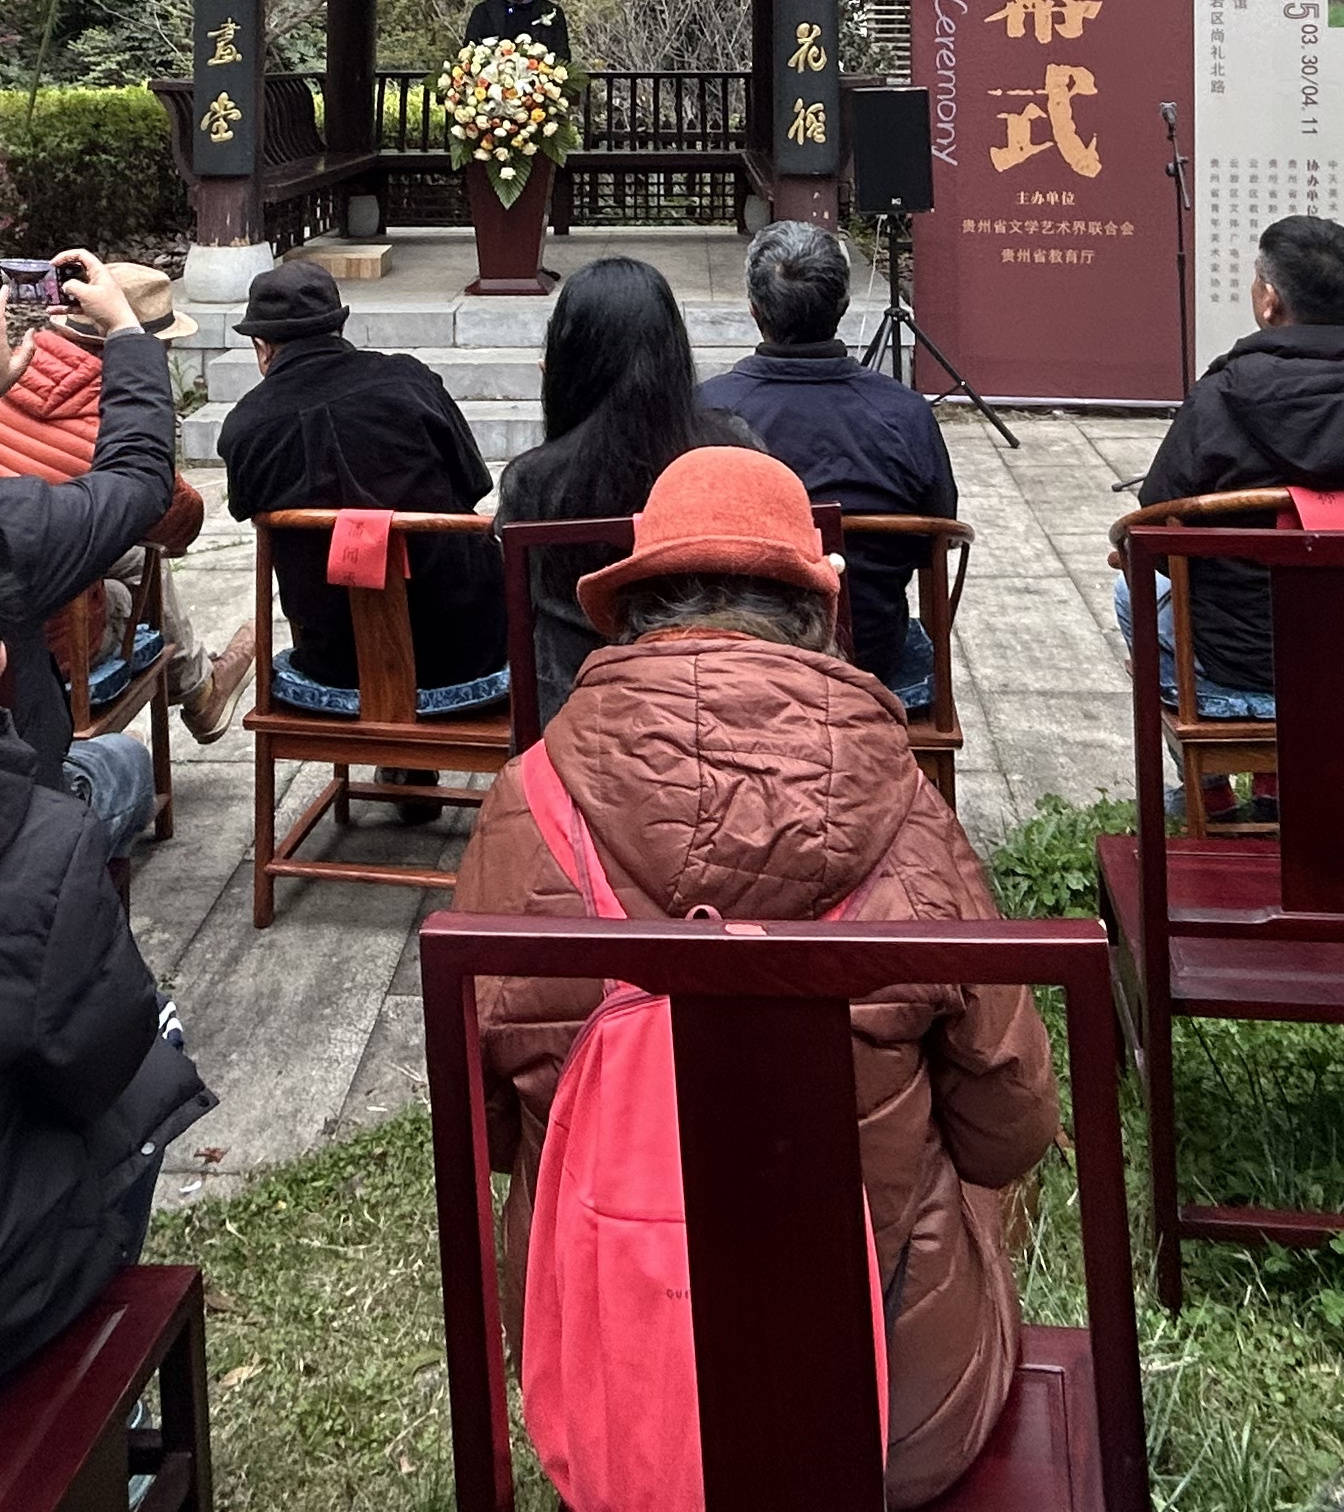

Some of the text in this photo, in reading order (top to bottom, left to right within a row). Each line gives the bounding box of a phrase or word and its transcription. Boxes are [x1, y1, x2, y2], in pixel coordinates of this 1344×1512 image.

[1016, 191, 1076, 206] 主办单位
[962, 219, 1136, 236] 贵州省文学艺术界联合会
[1001, 248, 1096, 265] 贵州省教育厅
